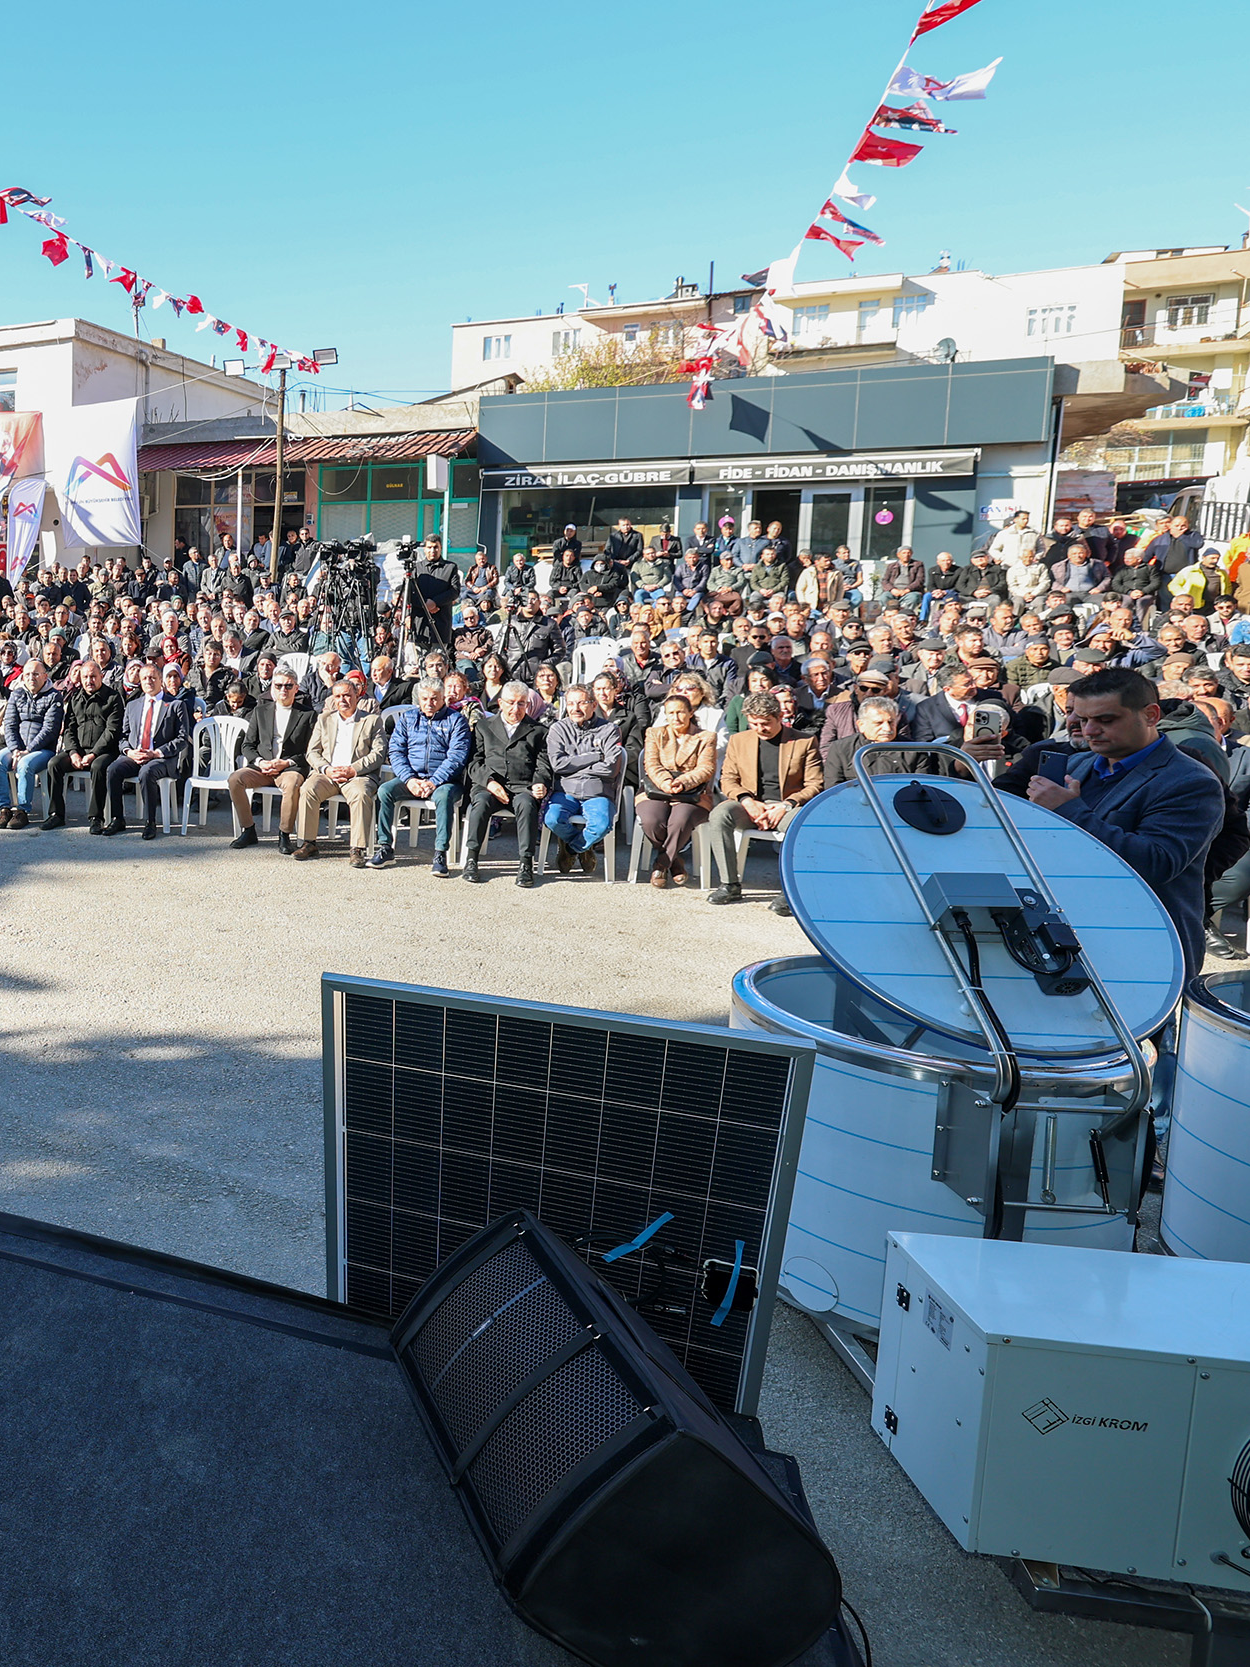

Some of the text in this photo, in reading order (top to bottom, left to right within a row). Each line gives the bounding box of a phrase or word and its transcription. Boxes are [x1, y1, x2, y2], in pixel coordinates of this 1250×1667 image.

[504, 470, 671, 486] ZİRAİ İLAÇ-GÜBRE
[719, 465, 752, 480] FİDE
[765, 464, 812, 478] FİDAN
[826, 460, 943, 477] DANIŞMANLIK
[1098, 1417, 1148, 1432] KROM
